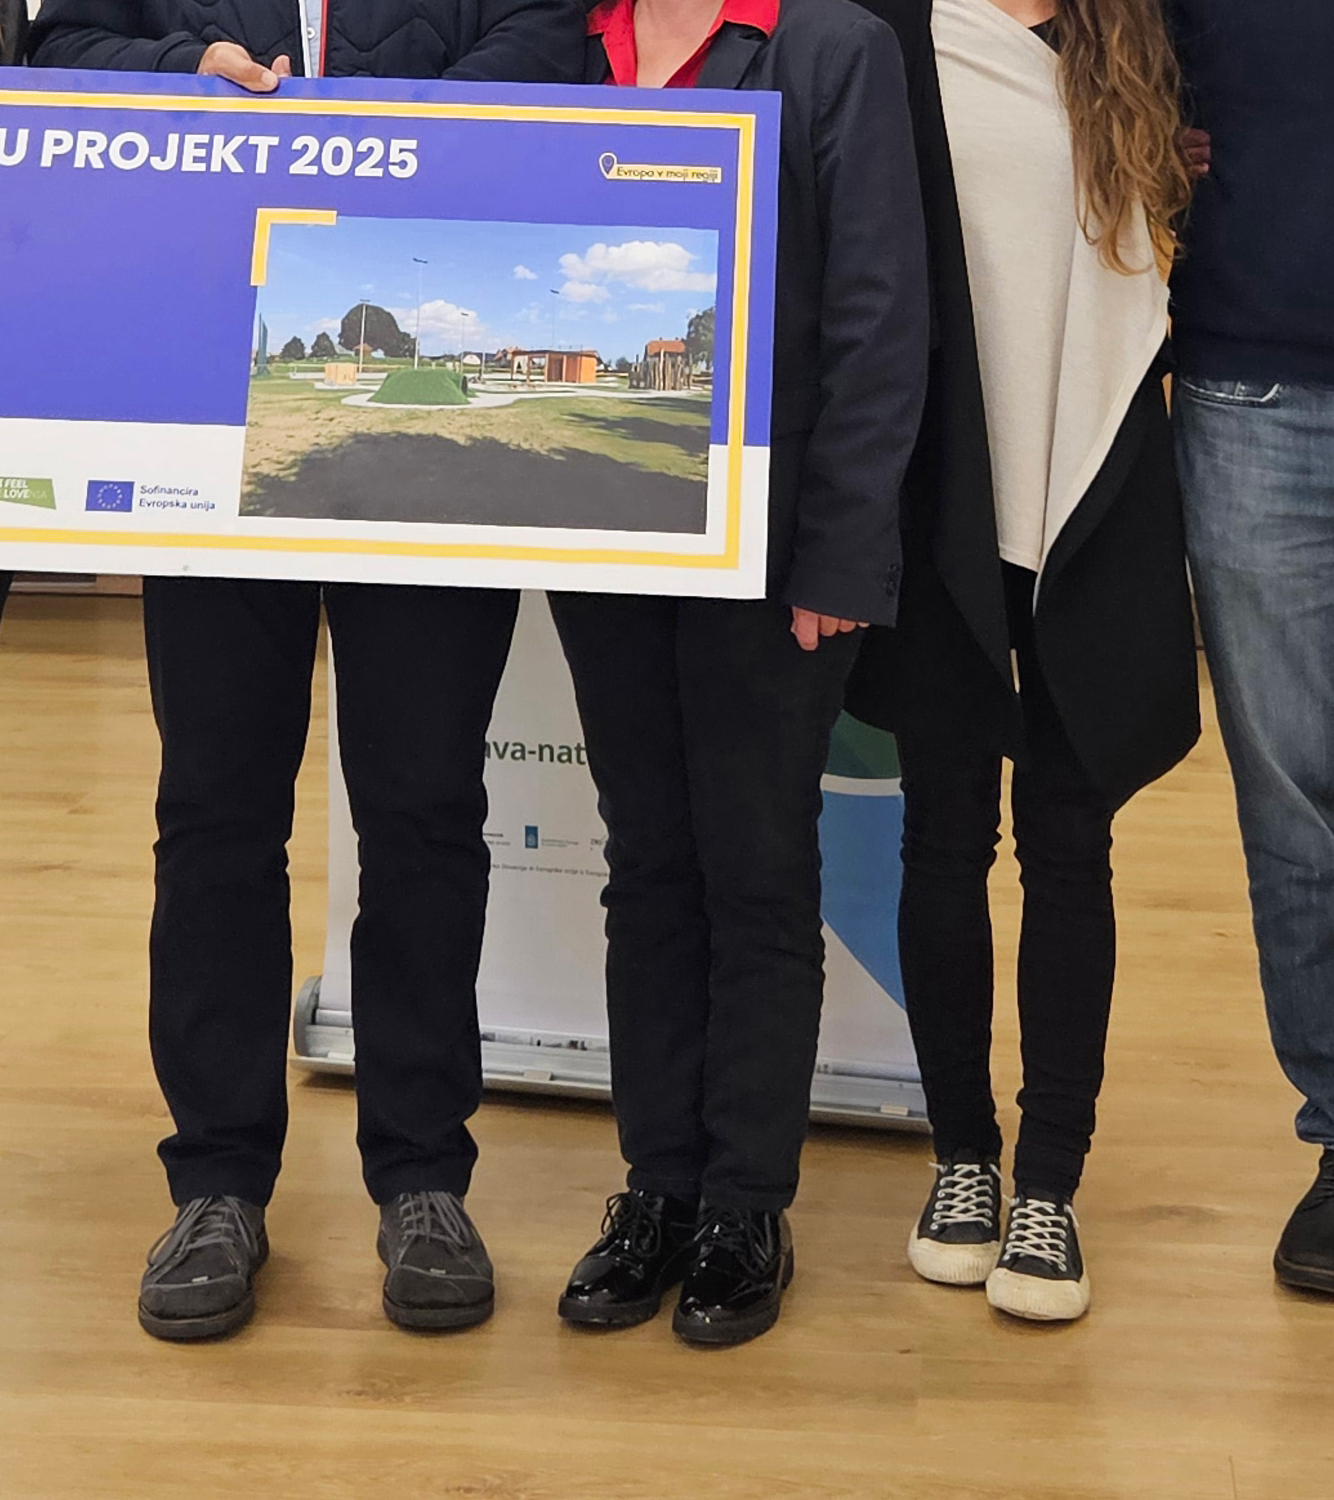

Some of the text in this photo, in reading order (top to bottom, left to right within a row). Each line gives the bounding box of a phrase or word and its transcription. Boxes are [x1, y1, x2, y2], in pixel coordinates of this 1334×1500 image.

[40, 130, 279, 175] PROJEKT
[288, 136, 420, 179] 2025
[616, 166, 655, 181] Evropa
[140, 484, 199, 497] Sofinancira
[139, 498, 216, 512] Evropska unija
